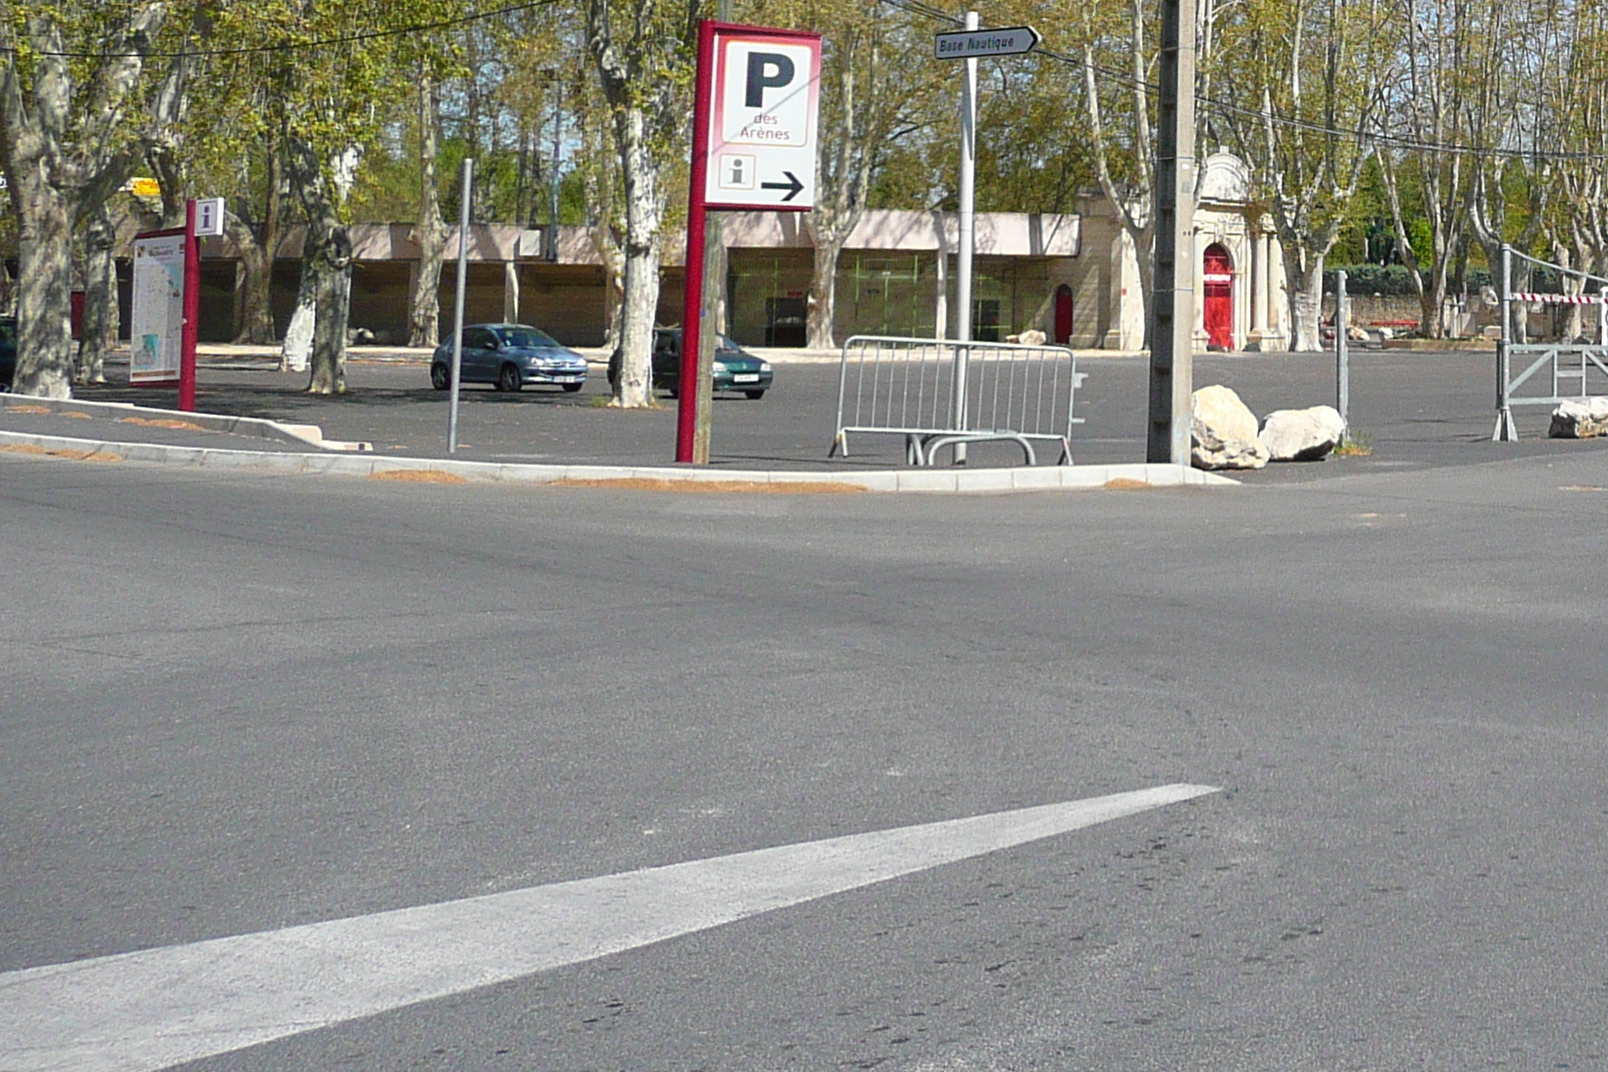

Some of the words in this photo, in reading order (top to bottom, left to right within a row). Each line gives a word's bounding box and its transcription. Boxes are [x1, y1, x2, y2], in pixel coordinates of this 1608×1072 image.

[940, 40, 963, 52] Base
[967, 36, 1014, 51] Nautique
[745, 51, 795, 108] P
[753, 113, 778, 125] des
[740, 125, 790, 140] Arènes
